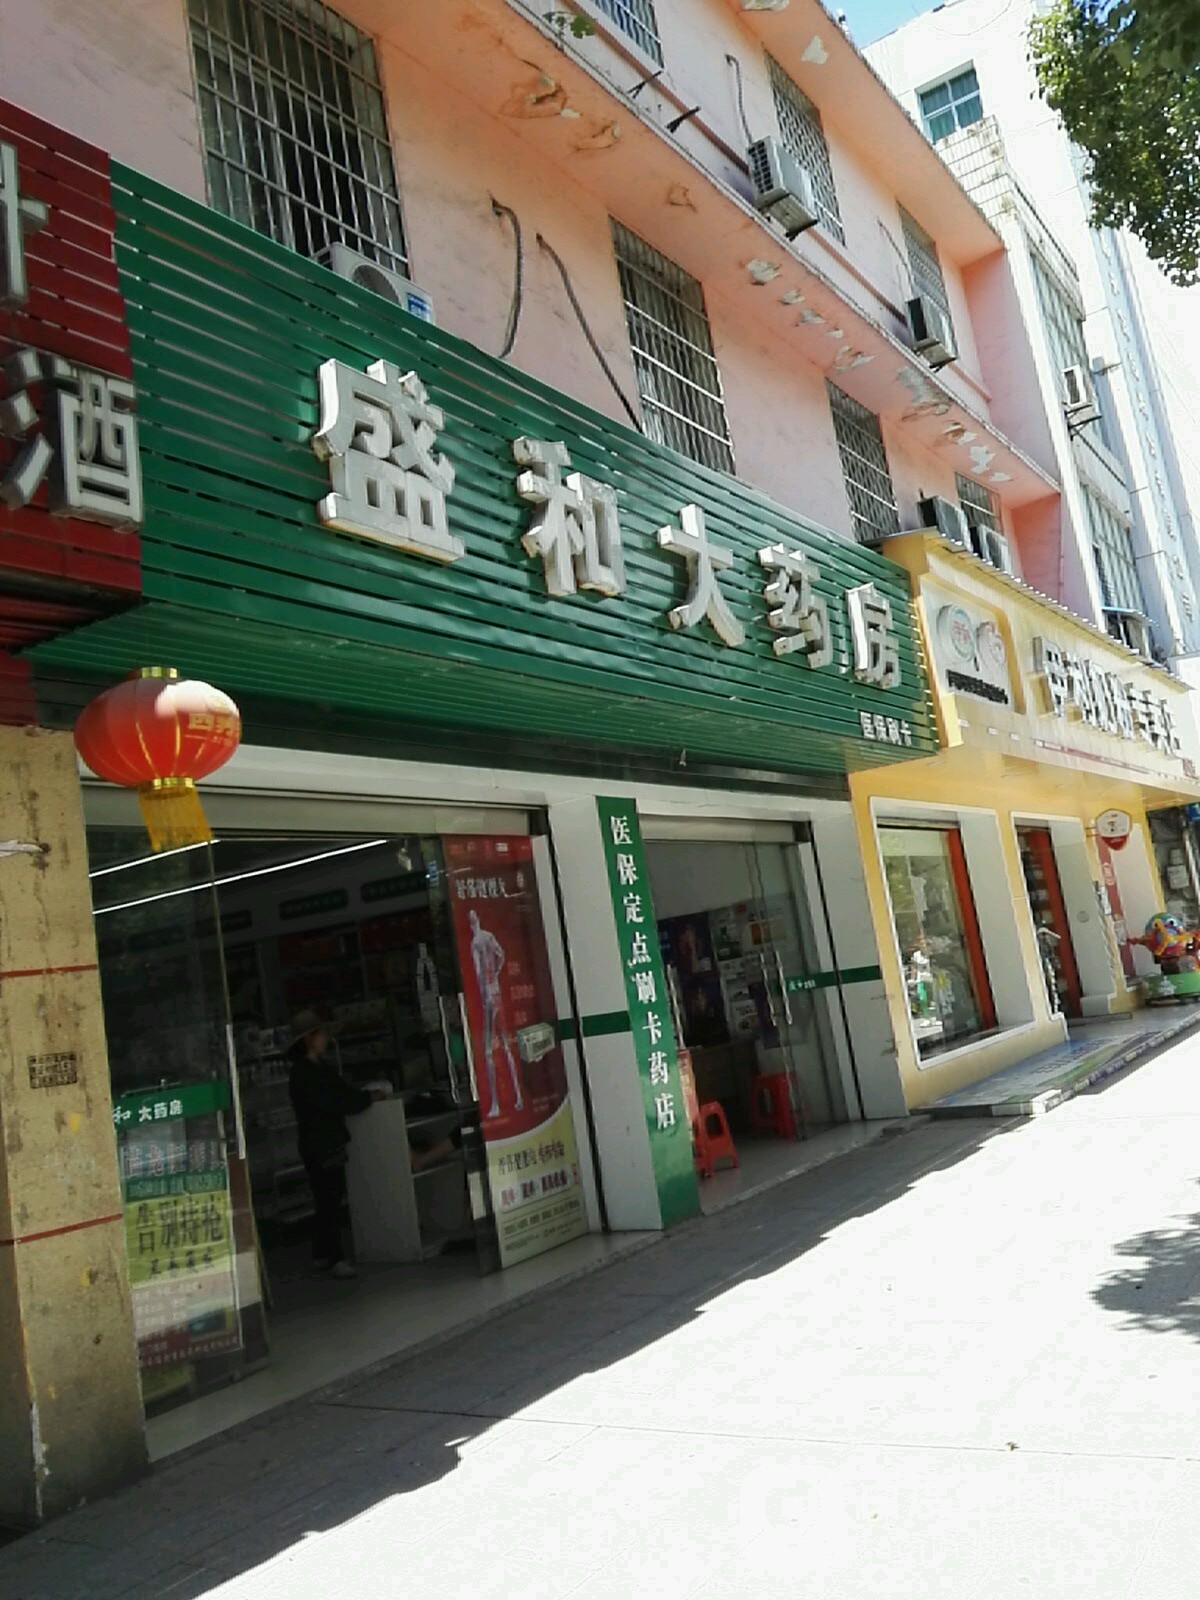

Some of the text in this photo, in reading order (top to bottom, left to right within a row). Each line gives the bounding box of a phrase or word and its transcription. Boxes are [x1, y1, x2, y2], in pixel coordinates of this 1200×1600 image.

[311, 356, 903, 690] 盛和大药房
[859, 711, 913, 747] 医保刷卡
